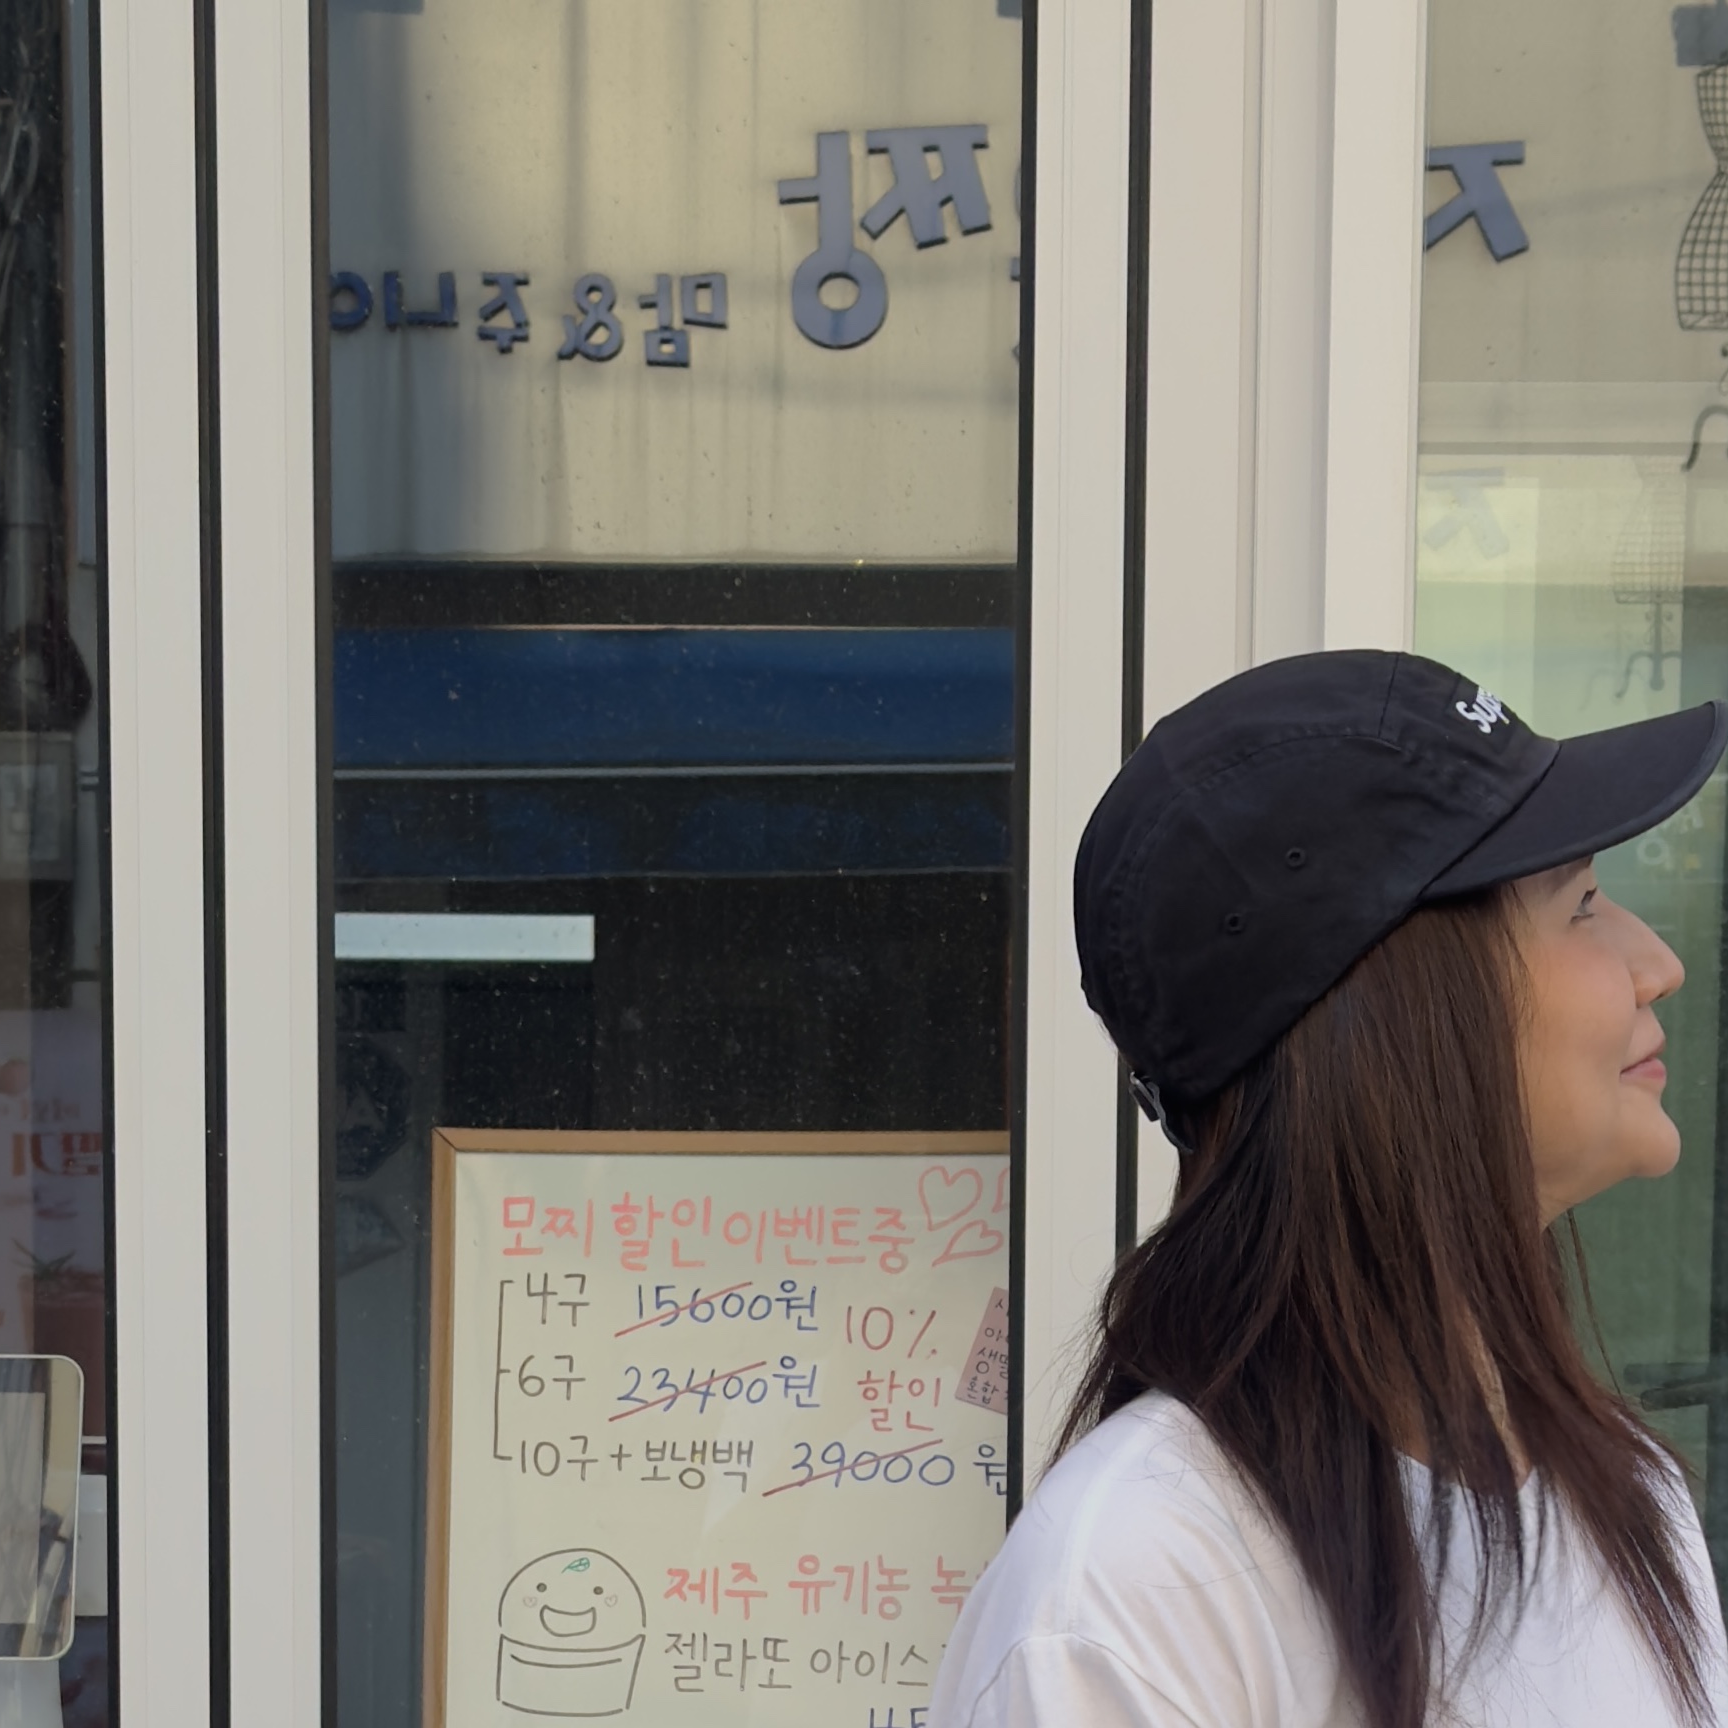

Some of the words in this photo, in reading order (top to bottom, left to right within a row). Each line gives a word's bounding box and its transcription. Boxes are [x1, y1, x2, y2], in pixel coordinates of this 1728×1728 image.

[502, 1196, 594, 1258] 모찌
[526, 1272, 589, 1326] 4구
[845, 1305, 938, 1360] 10%
[518, 1355, 586, 1400] 6구
[858, 1370, 940, 1432] 할인
[664, 1562, 768, 1620] 제주
[788, 1554, 910, 1620] 유기농
[931, 1555, 992, 1616] 녹
[664, 1632, 792, 1693] 젤라또
